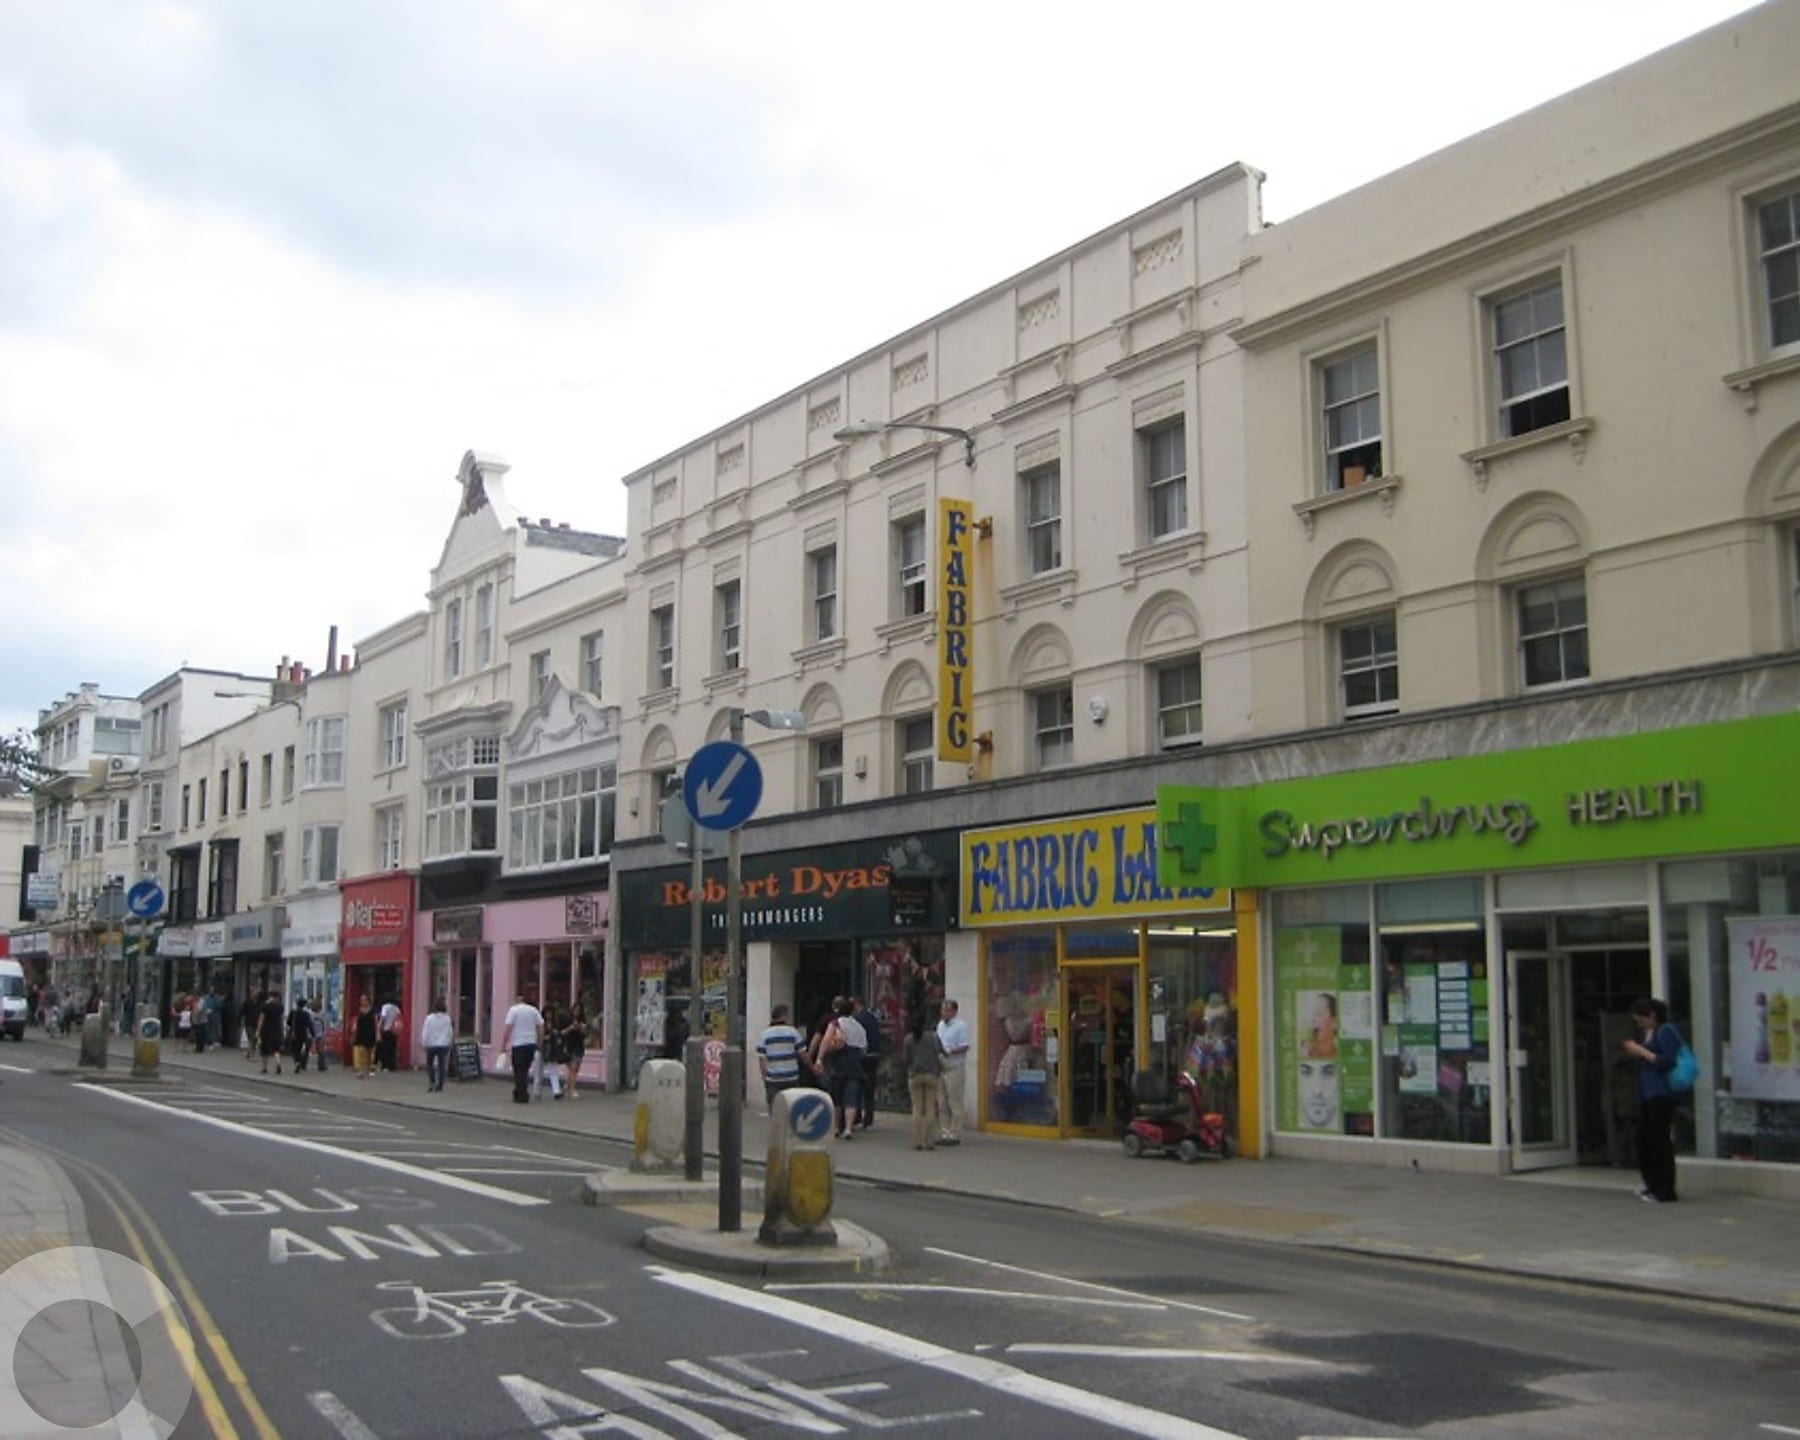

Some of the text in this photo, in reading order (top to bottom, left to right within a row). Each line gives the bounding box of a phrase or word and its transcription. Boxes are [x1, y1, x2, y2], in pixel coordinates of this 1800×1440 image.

[946, 510, 968, 749] FABRIC
[1258, 778, 1701, 858] Superdrug HEALTH
[790, 863, 890, 898] Dyas
[970, 823, 1215, 914] FABRIC LA
[190, 1188, 436, 1215] BUS
[269, 1223, 523, 1263] AND
